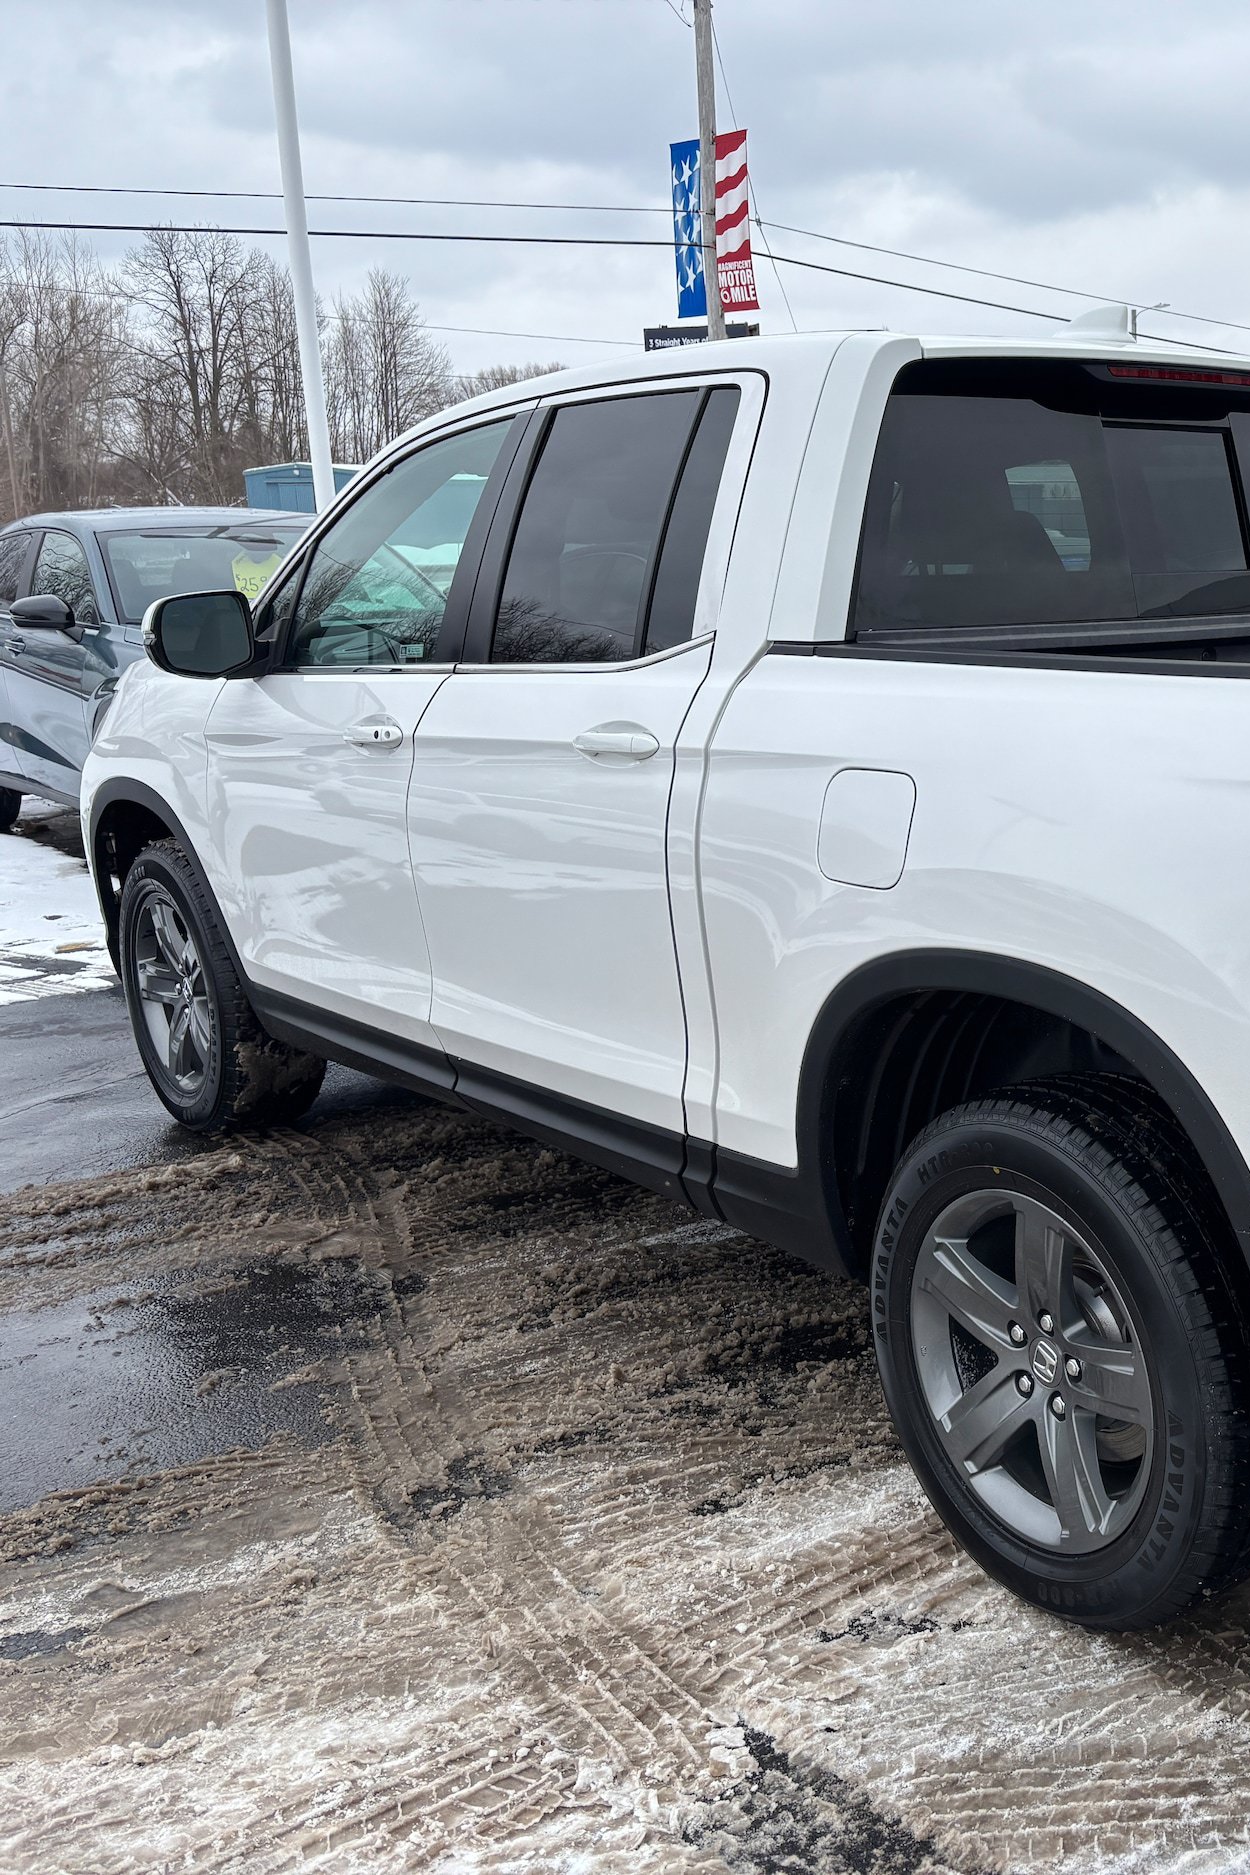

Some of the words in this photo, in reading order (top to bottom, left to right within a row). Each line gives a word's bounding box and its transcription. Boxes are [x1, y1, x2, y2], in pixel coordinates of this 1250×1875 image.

[718, 269, 754, 288] MOTOR
[730, 285, 757, 303] MILE
[648, 339, 654, 348] 3
[654, 337, 681, 348] Straight
[875, 1196, 909, 1346] ADVANTA
[1136, 1409, 1185, 1572] ADVANTA
